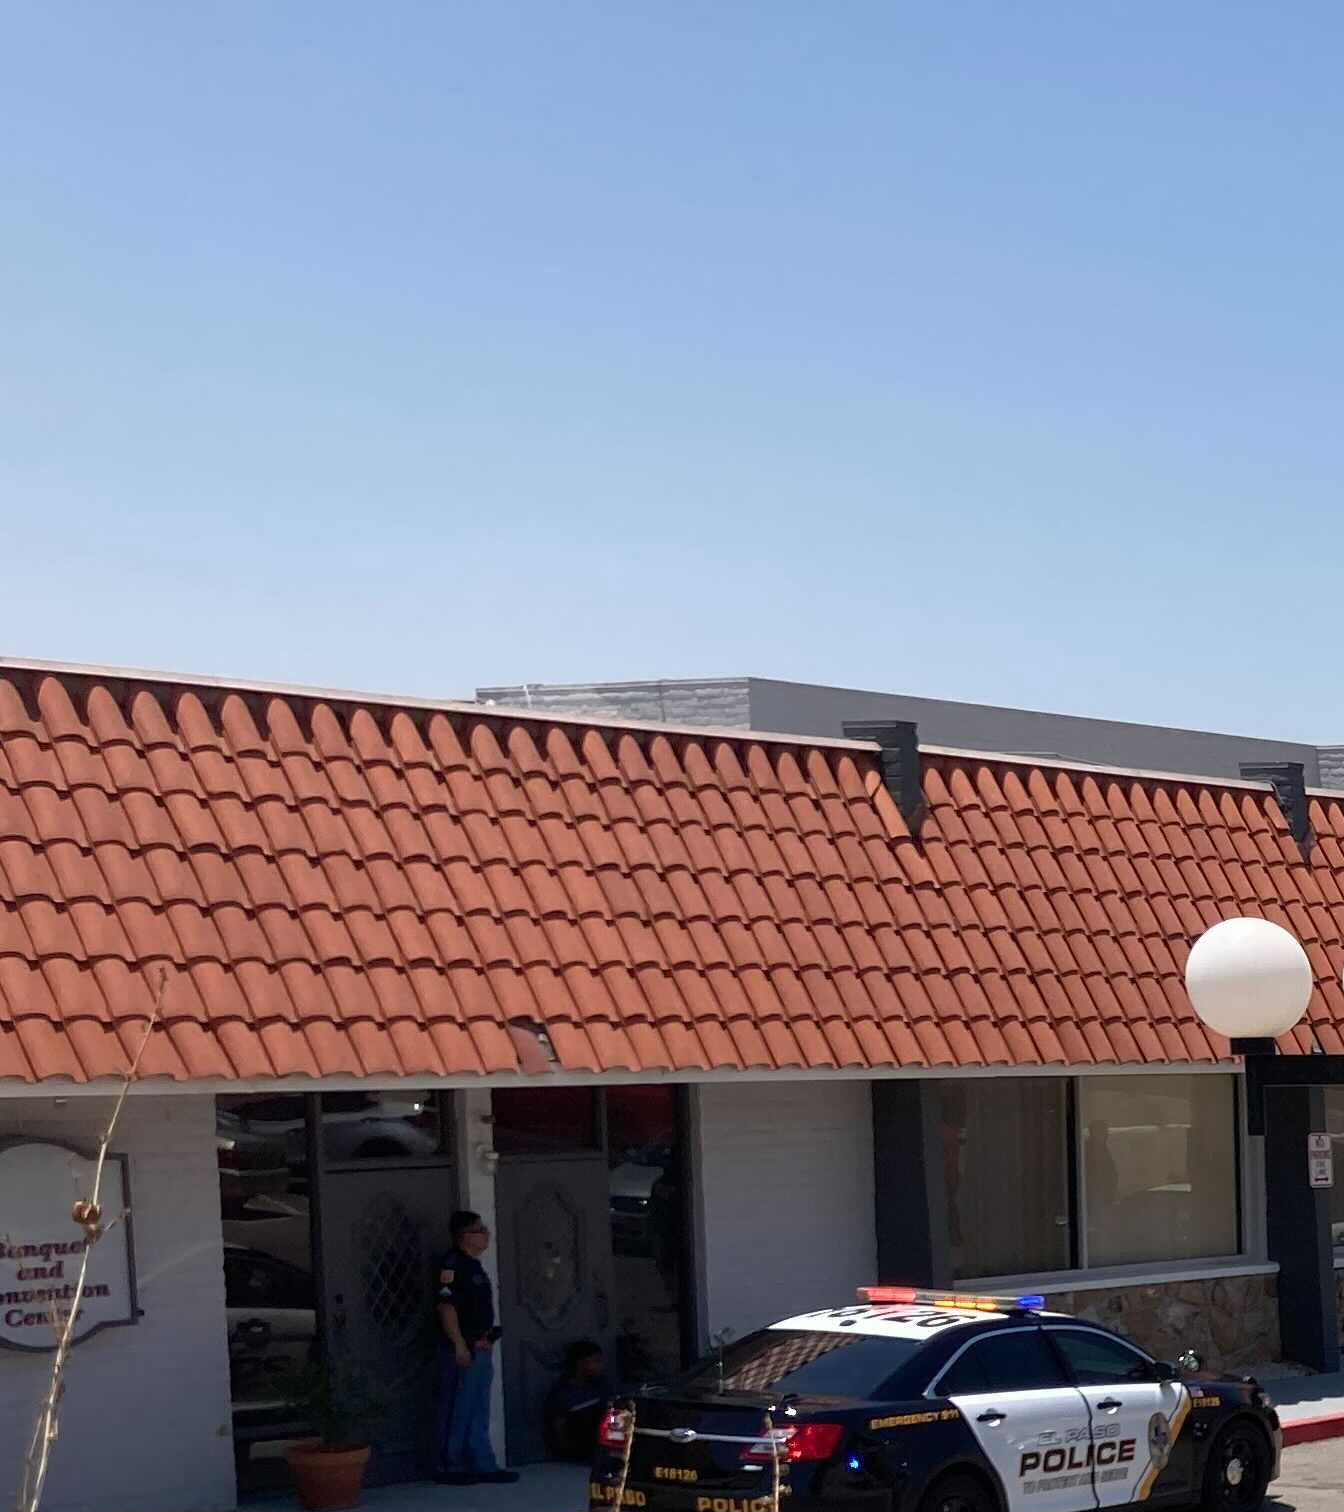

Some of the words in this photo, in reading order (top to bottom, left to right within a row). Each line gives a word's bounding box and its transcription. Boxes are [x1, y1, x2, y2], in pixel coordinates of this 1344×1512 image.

[1038, 1430, 1062, 1447] EL
[1064, 1423, 1121, 1443] PASO
[1020, 1439, 1136, 1477] POLICE
[655, 1467, 698, 1482] E18126
